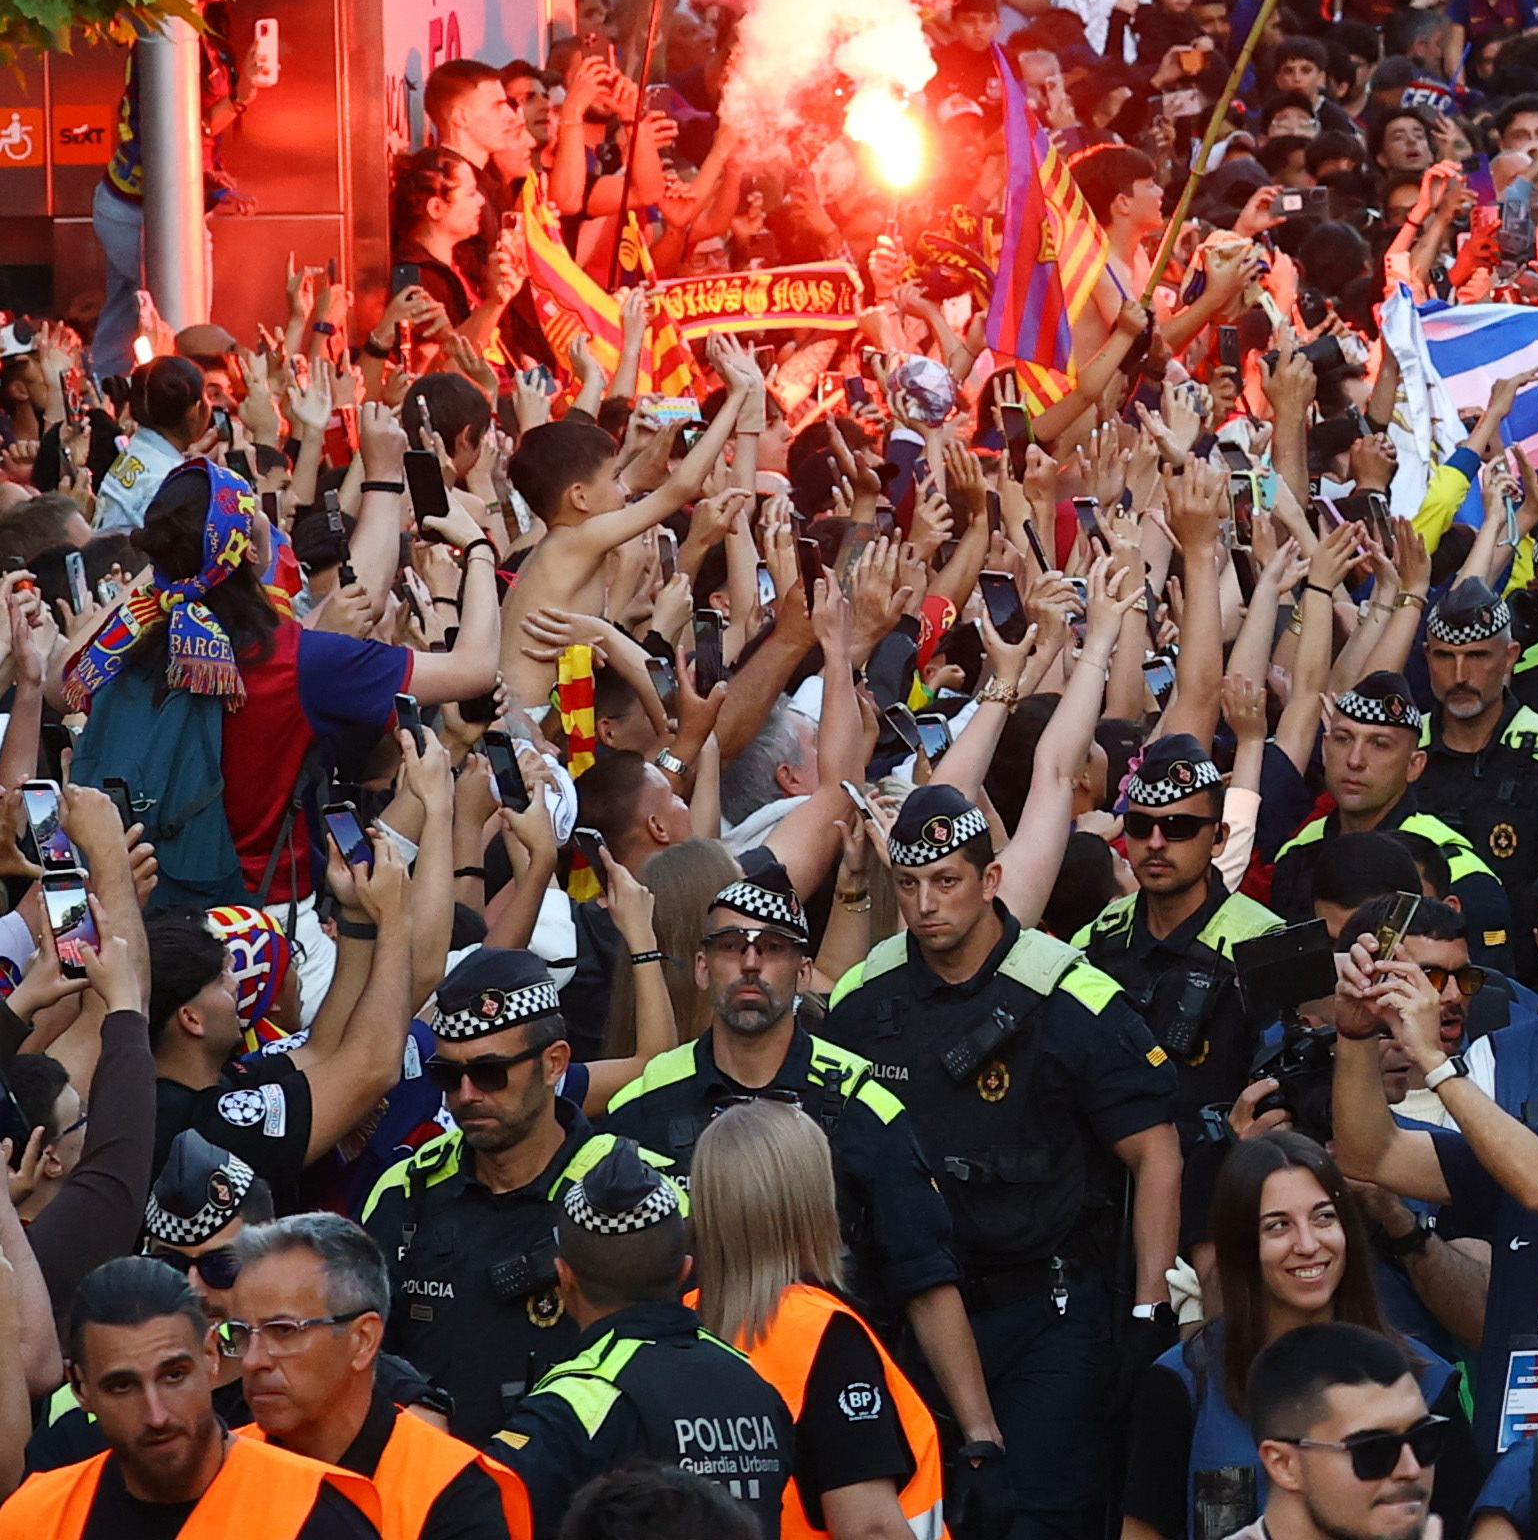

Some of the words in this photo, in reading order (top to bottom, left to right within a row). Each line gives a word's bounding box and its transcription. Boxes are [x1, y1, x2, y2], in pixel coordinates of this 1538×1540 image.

[60, 126, 105, 146] SIXT
[849, 1391, 872, 1409] BP
[673, 1415, 779, 1455] POLICIA
[679, 1454, 738, 1476] Guàrdia
[738, 1455, 781, 1475] Urbana
